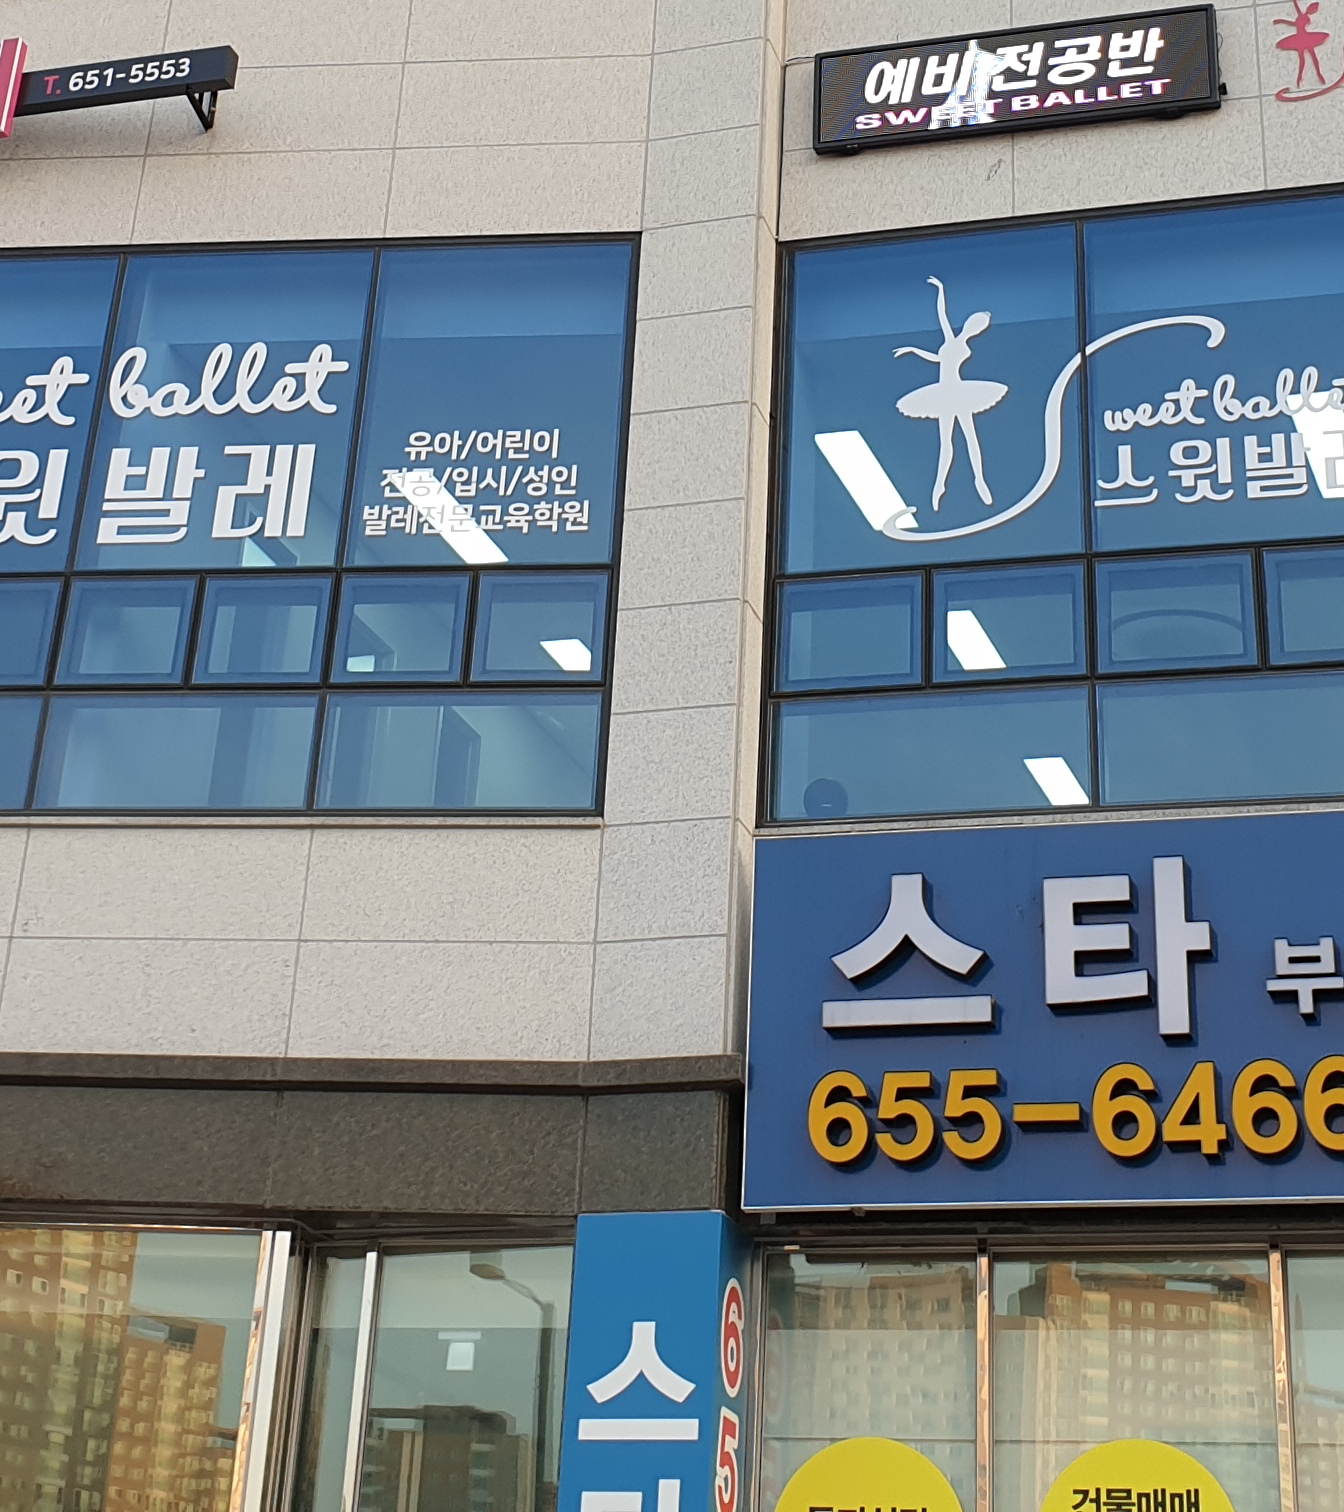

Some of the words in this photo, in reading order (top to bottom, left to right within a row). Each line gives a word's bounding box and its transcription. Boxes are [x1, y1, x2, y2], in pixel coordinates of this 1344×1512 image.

[68, 57, 192, 92] 651-5553
[1010, 78, 1173, 112] BALLET
[109, 341, 350, 419] ballet
[405, 429, 560, 461] 유아/어린이
[380, 464, 579, 498] 전공/입시/성인
[362, 500, 591, 536] 발레전문교육학원
[821, 855, 1213, 1039] 스타
